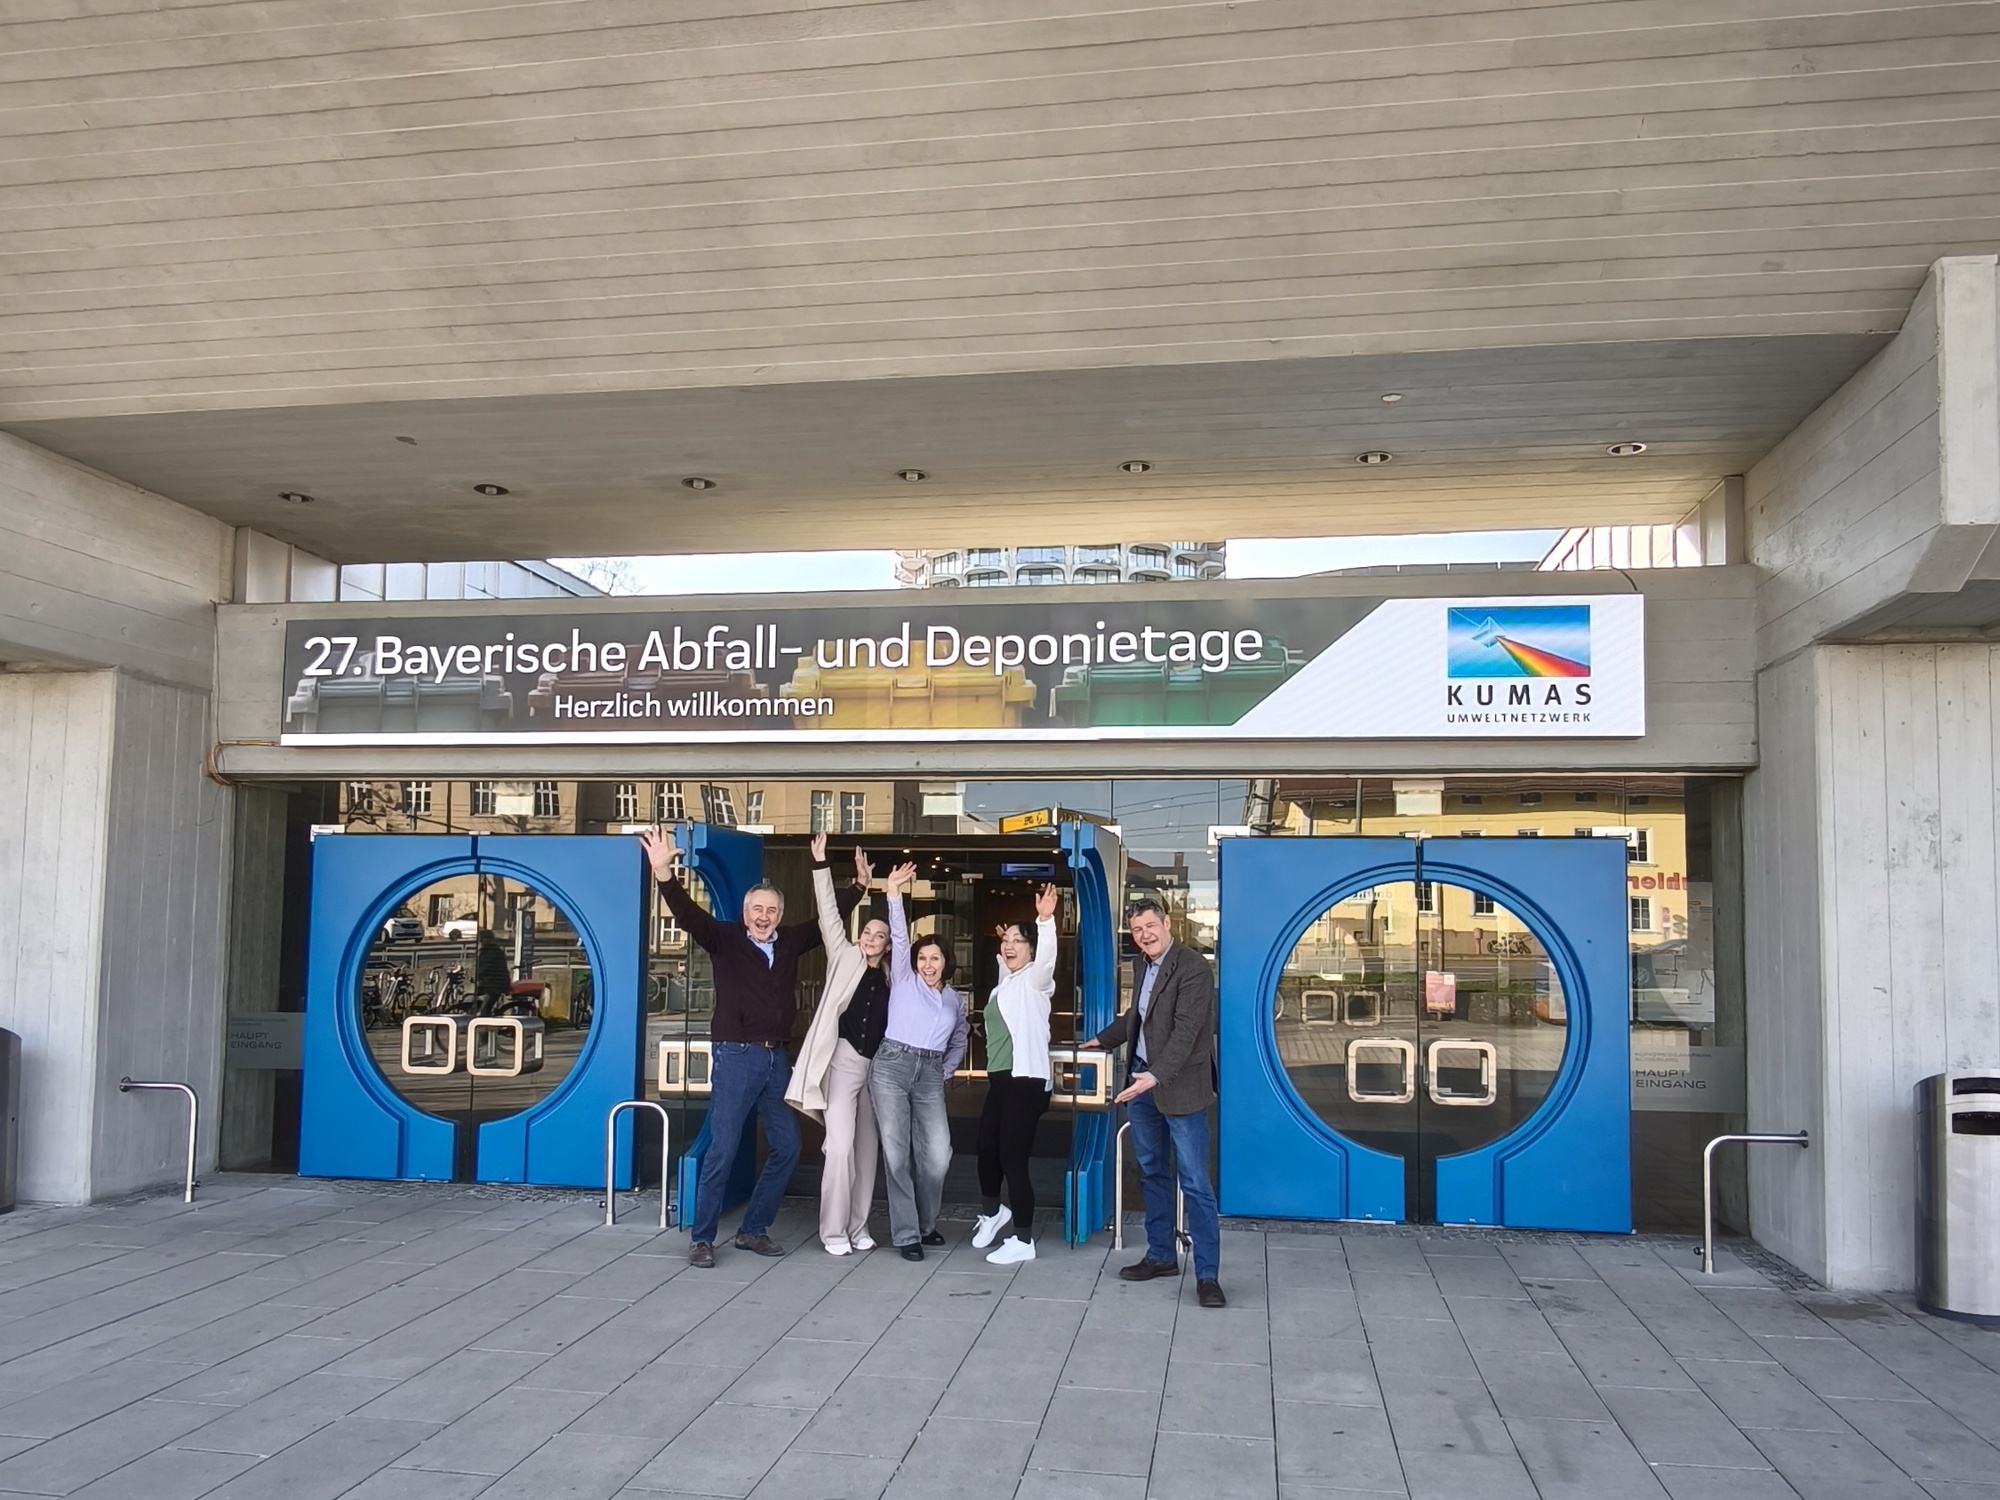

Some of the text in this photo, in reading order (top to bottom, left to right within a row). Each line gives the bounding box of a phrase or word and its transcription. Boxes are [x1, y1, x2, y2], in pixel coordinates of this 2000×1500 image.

[303, 620, 1263, 684] 27. Bayerische Abfall- und Deponietage
[1447, 683, 1592, 706] KUMAS
[554, 691, 834, 718] Herzlich willkommen
[1447, 712, 1591, 723] UMWELTNETZWERK
[230, 1041, 282, 1049] EINGANG
[1635, 1079, 1707, 1090] EINGANG
